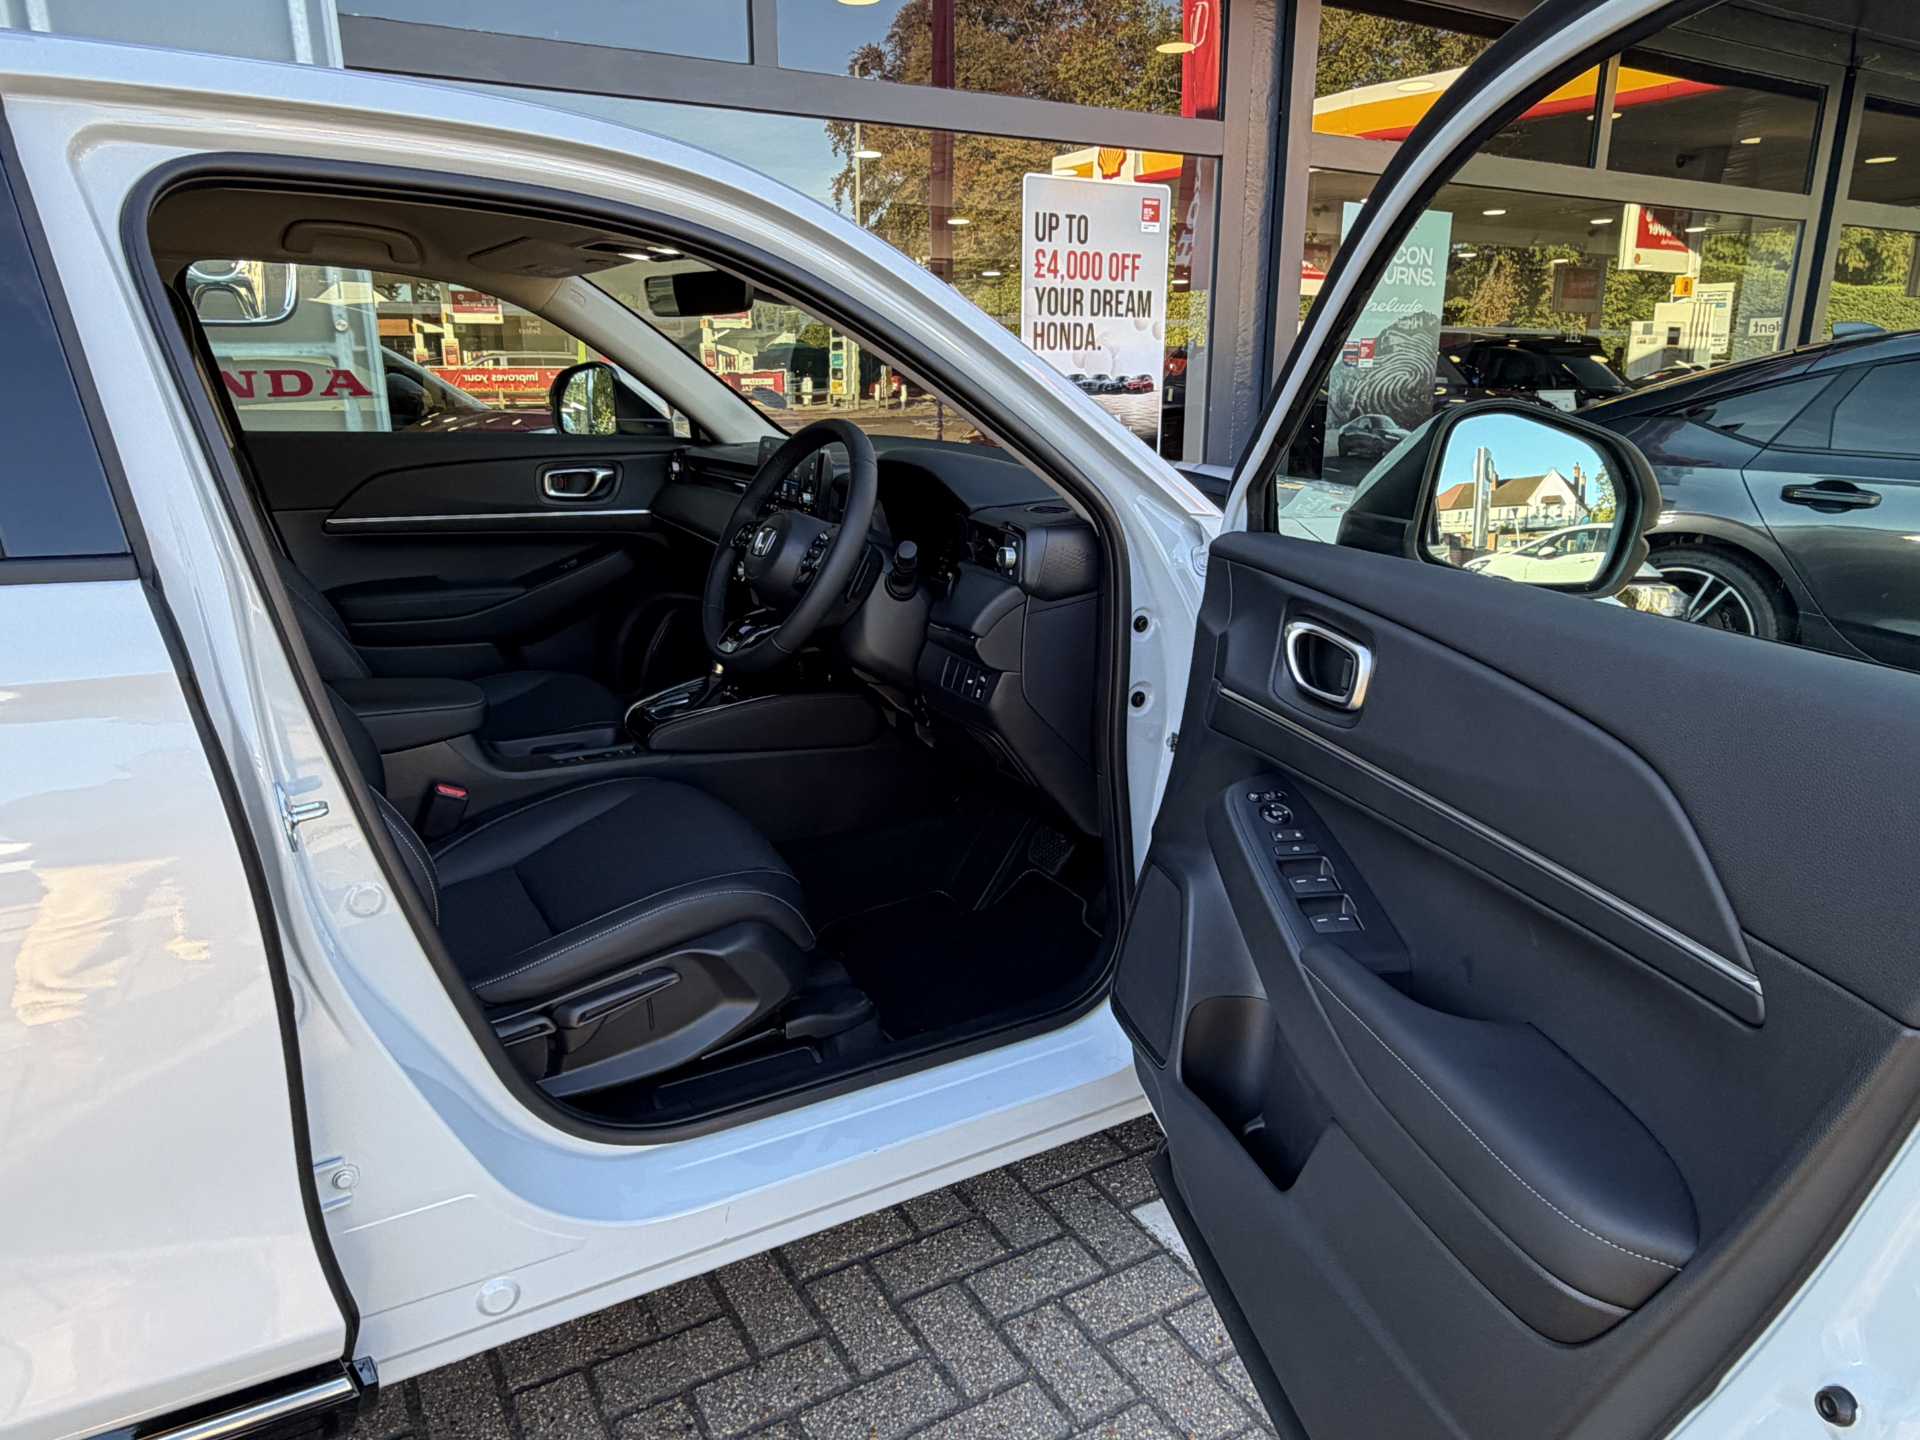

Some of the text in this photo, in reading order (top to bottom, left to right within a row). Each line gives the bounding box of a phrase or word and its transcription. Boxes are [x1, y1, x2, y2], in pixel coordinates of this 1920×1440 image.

[1034, 211, 1089, 245] UP TO
[1034, 248, 1142, 283] £4,000 OFF
[1393, 246, 1434, 266] CON
[1384, 266, 1437, 287] URNS.
[1034, 286, 1153, 319] YOUR DREAM
[1367, 297, 1425, 312] relude
[1033, 321, 1102, 351] HONDA.
[221, 369, 373, 399] NDA
